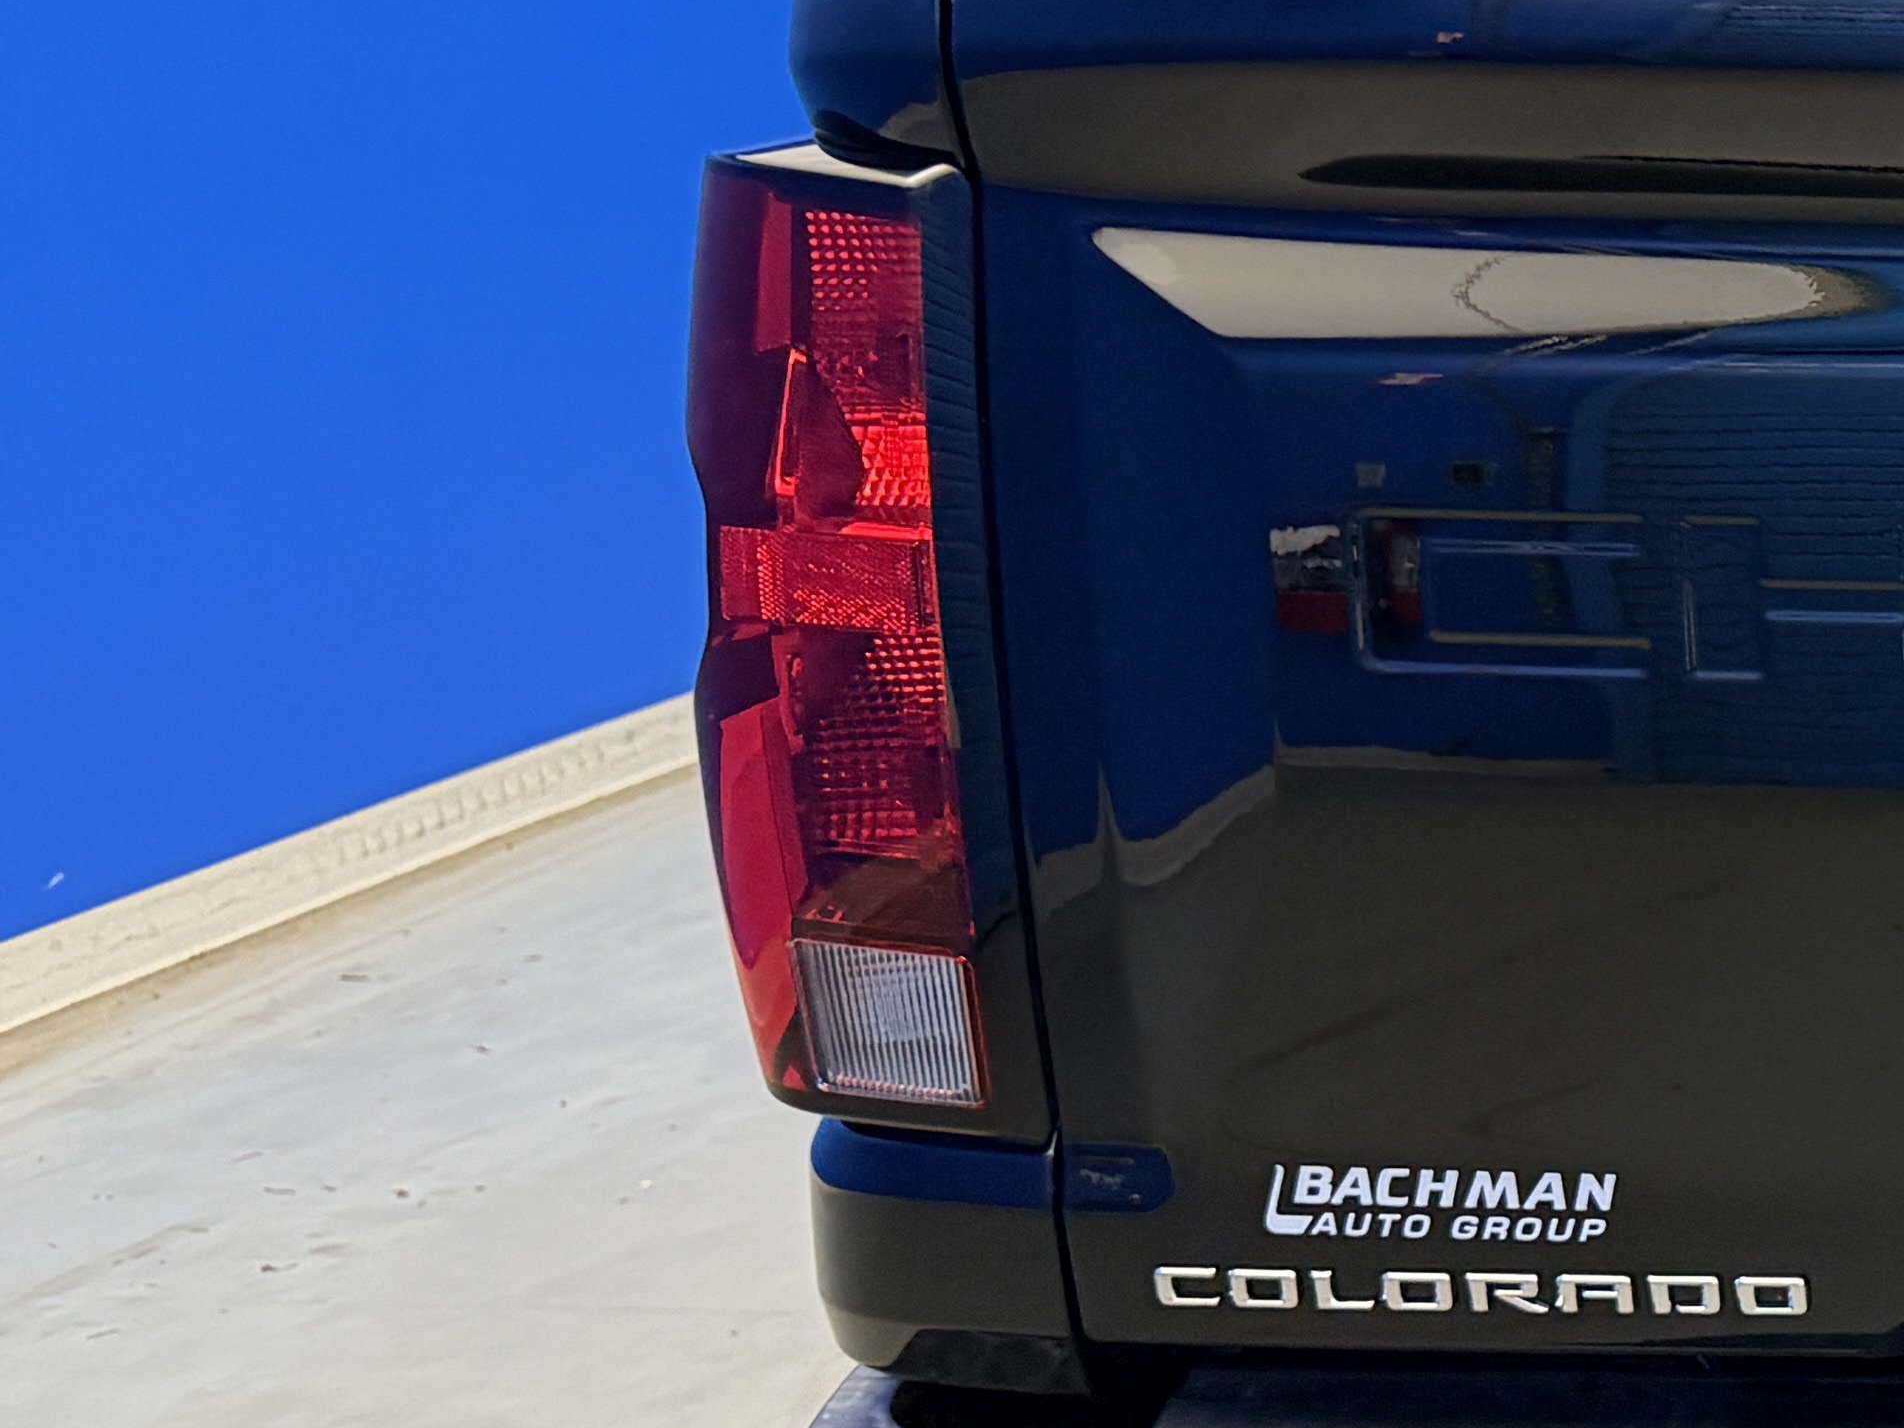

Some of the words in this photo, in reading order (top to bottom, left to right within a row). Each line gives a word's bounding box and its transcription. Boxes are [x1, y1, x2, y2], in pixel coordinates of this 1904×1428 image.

[1293, 1164, 1617, 1212] BACHMAN
[1308, 1212, 1432, 1240] AUTO
[1450, 1214, 1607, 1243] GROUP
[1153, 1266, 1809, 1316] COLORADO
